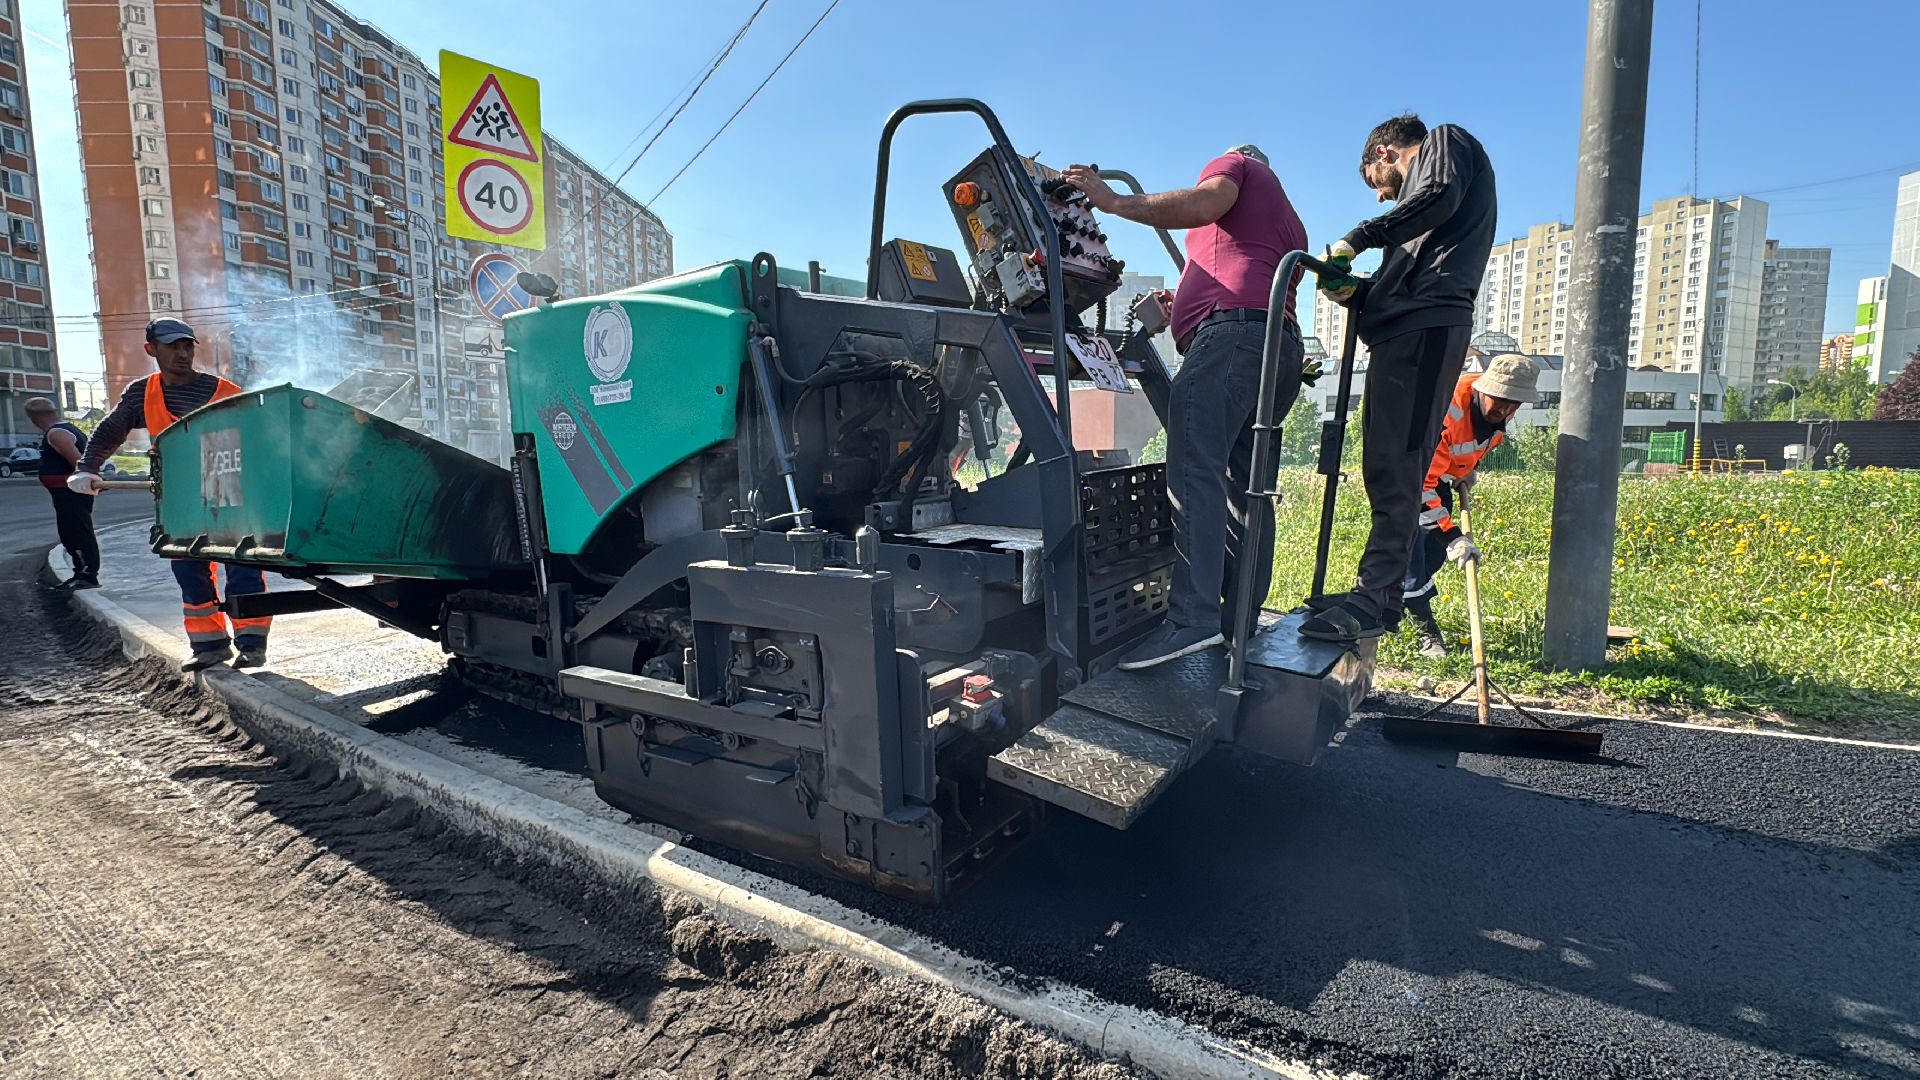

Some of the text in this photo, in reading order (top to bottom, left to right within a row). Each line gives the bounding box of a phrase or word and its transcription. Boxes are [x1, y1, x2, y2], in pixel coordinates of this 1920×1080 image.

[474, 181, 518, 214] 40
[552, 423, 577, 432] WIRTGEN
[202, 448, 241, 476] GELE
